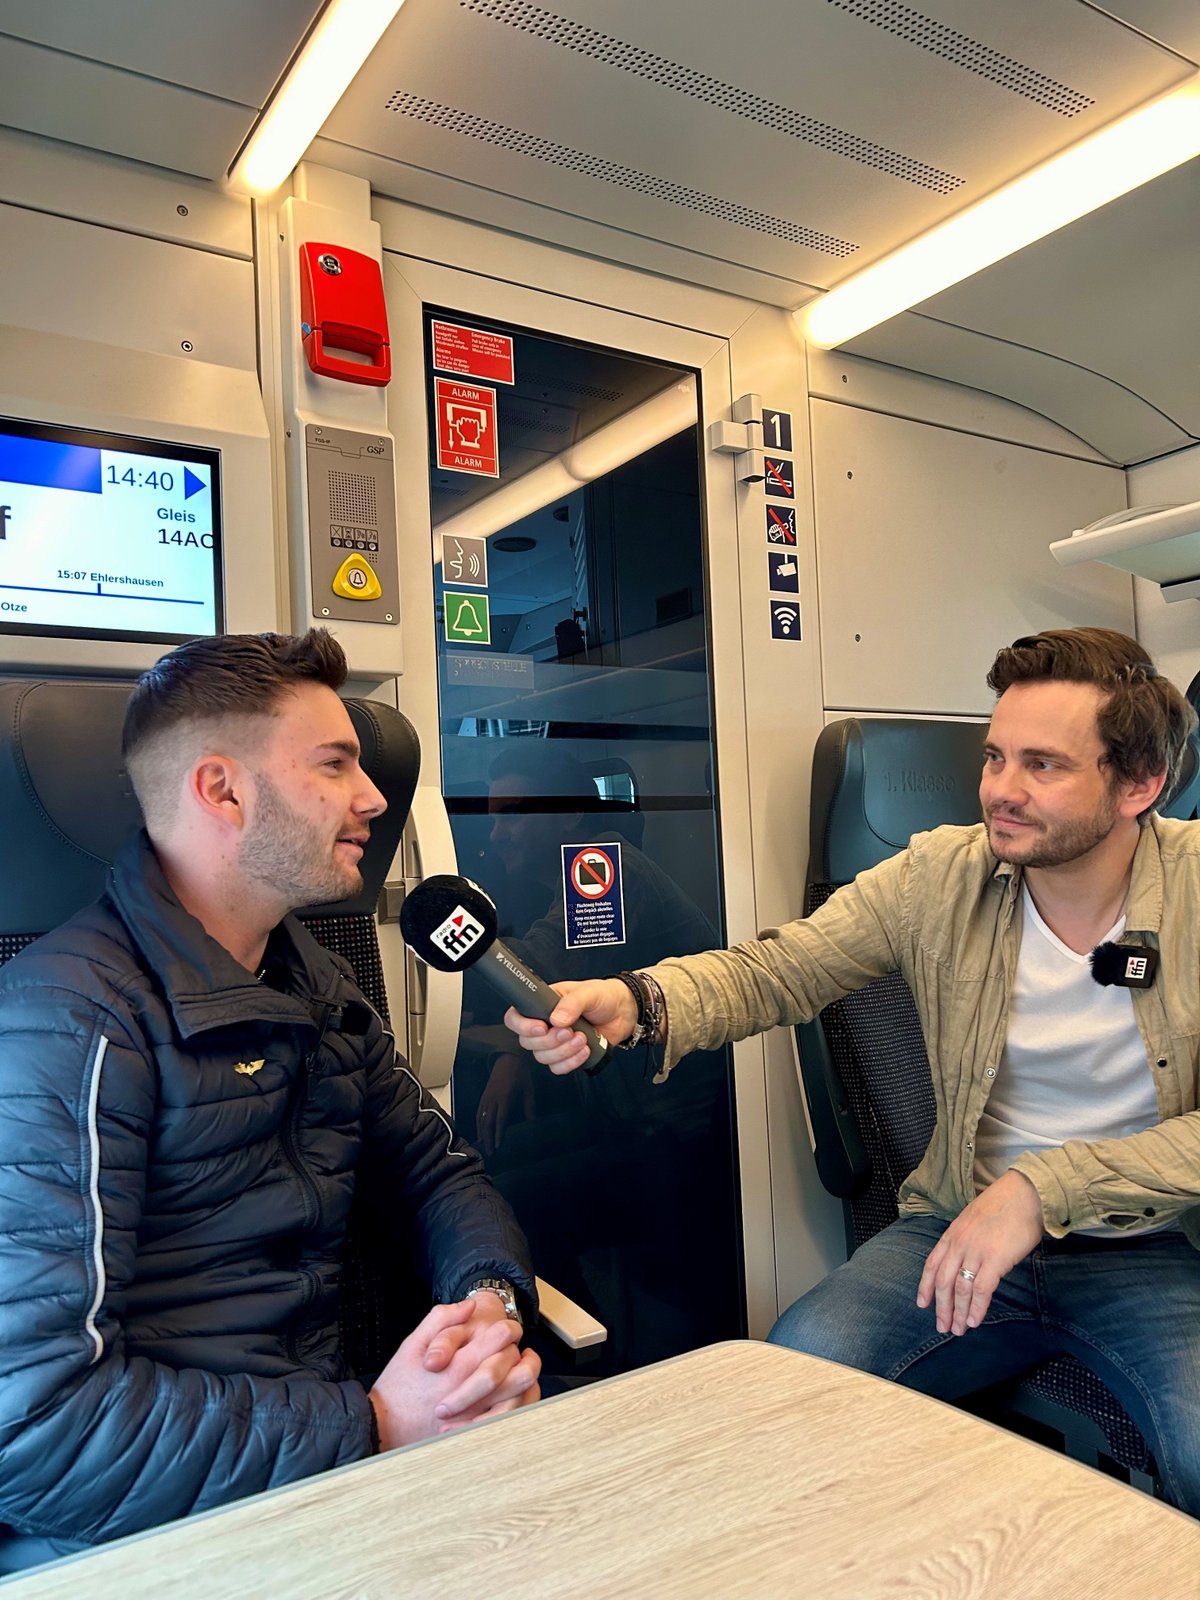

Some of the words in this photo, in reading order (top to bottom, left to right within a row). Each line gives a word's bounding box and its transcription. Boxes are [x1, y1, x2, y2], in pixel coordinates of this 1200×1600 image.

[451, 387, 480, 401] ALARM
[770, 414, 782, 447] 1
[366, 445, 385, 455] GSP
[454, 456, 482, 468] ALARM
[106, 464, 175, 492] 14:40
[156, 507, 197, 524] Gleis
[56, 569, 88, 582] 15:07
[89, 572, 165, 588] Ehlershausen
[0, 601, 29, 613] Otze
[901, 770, 956, 793] Klasse
[436, 923, 452, 939] radio
[442, 923, 480, 955] ffn
[502, 957, 538, 992] YELLOWTEC
